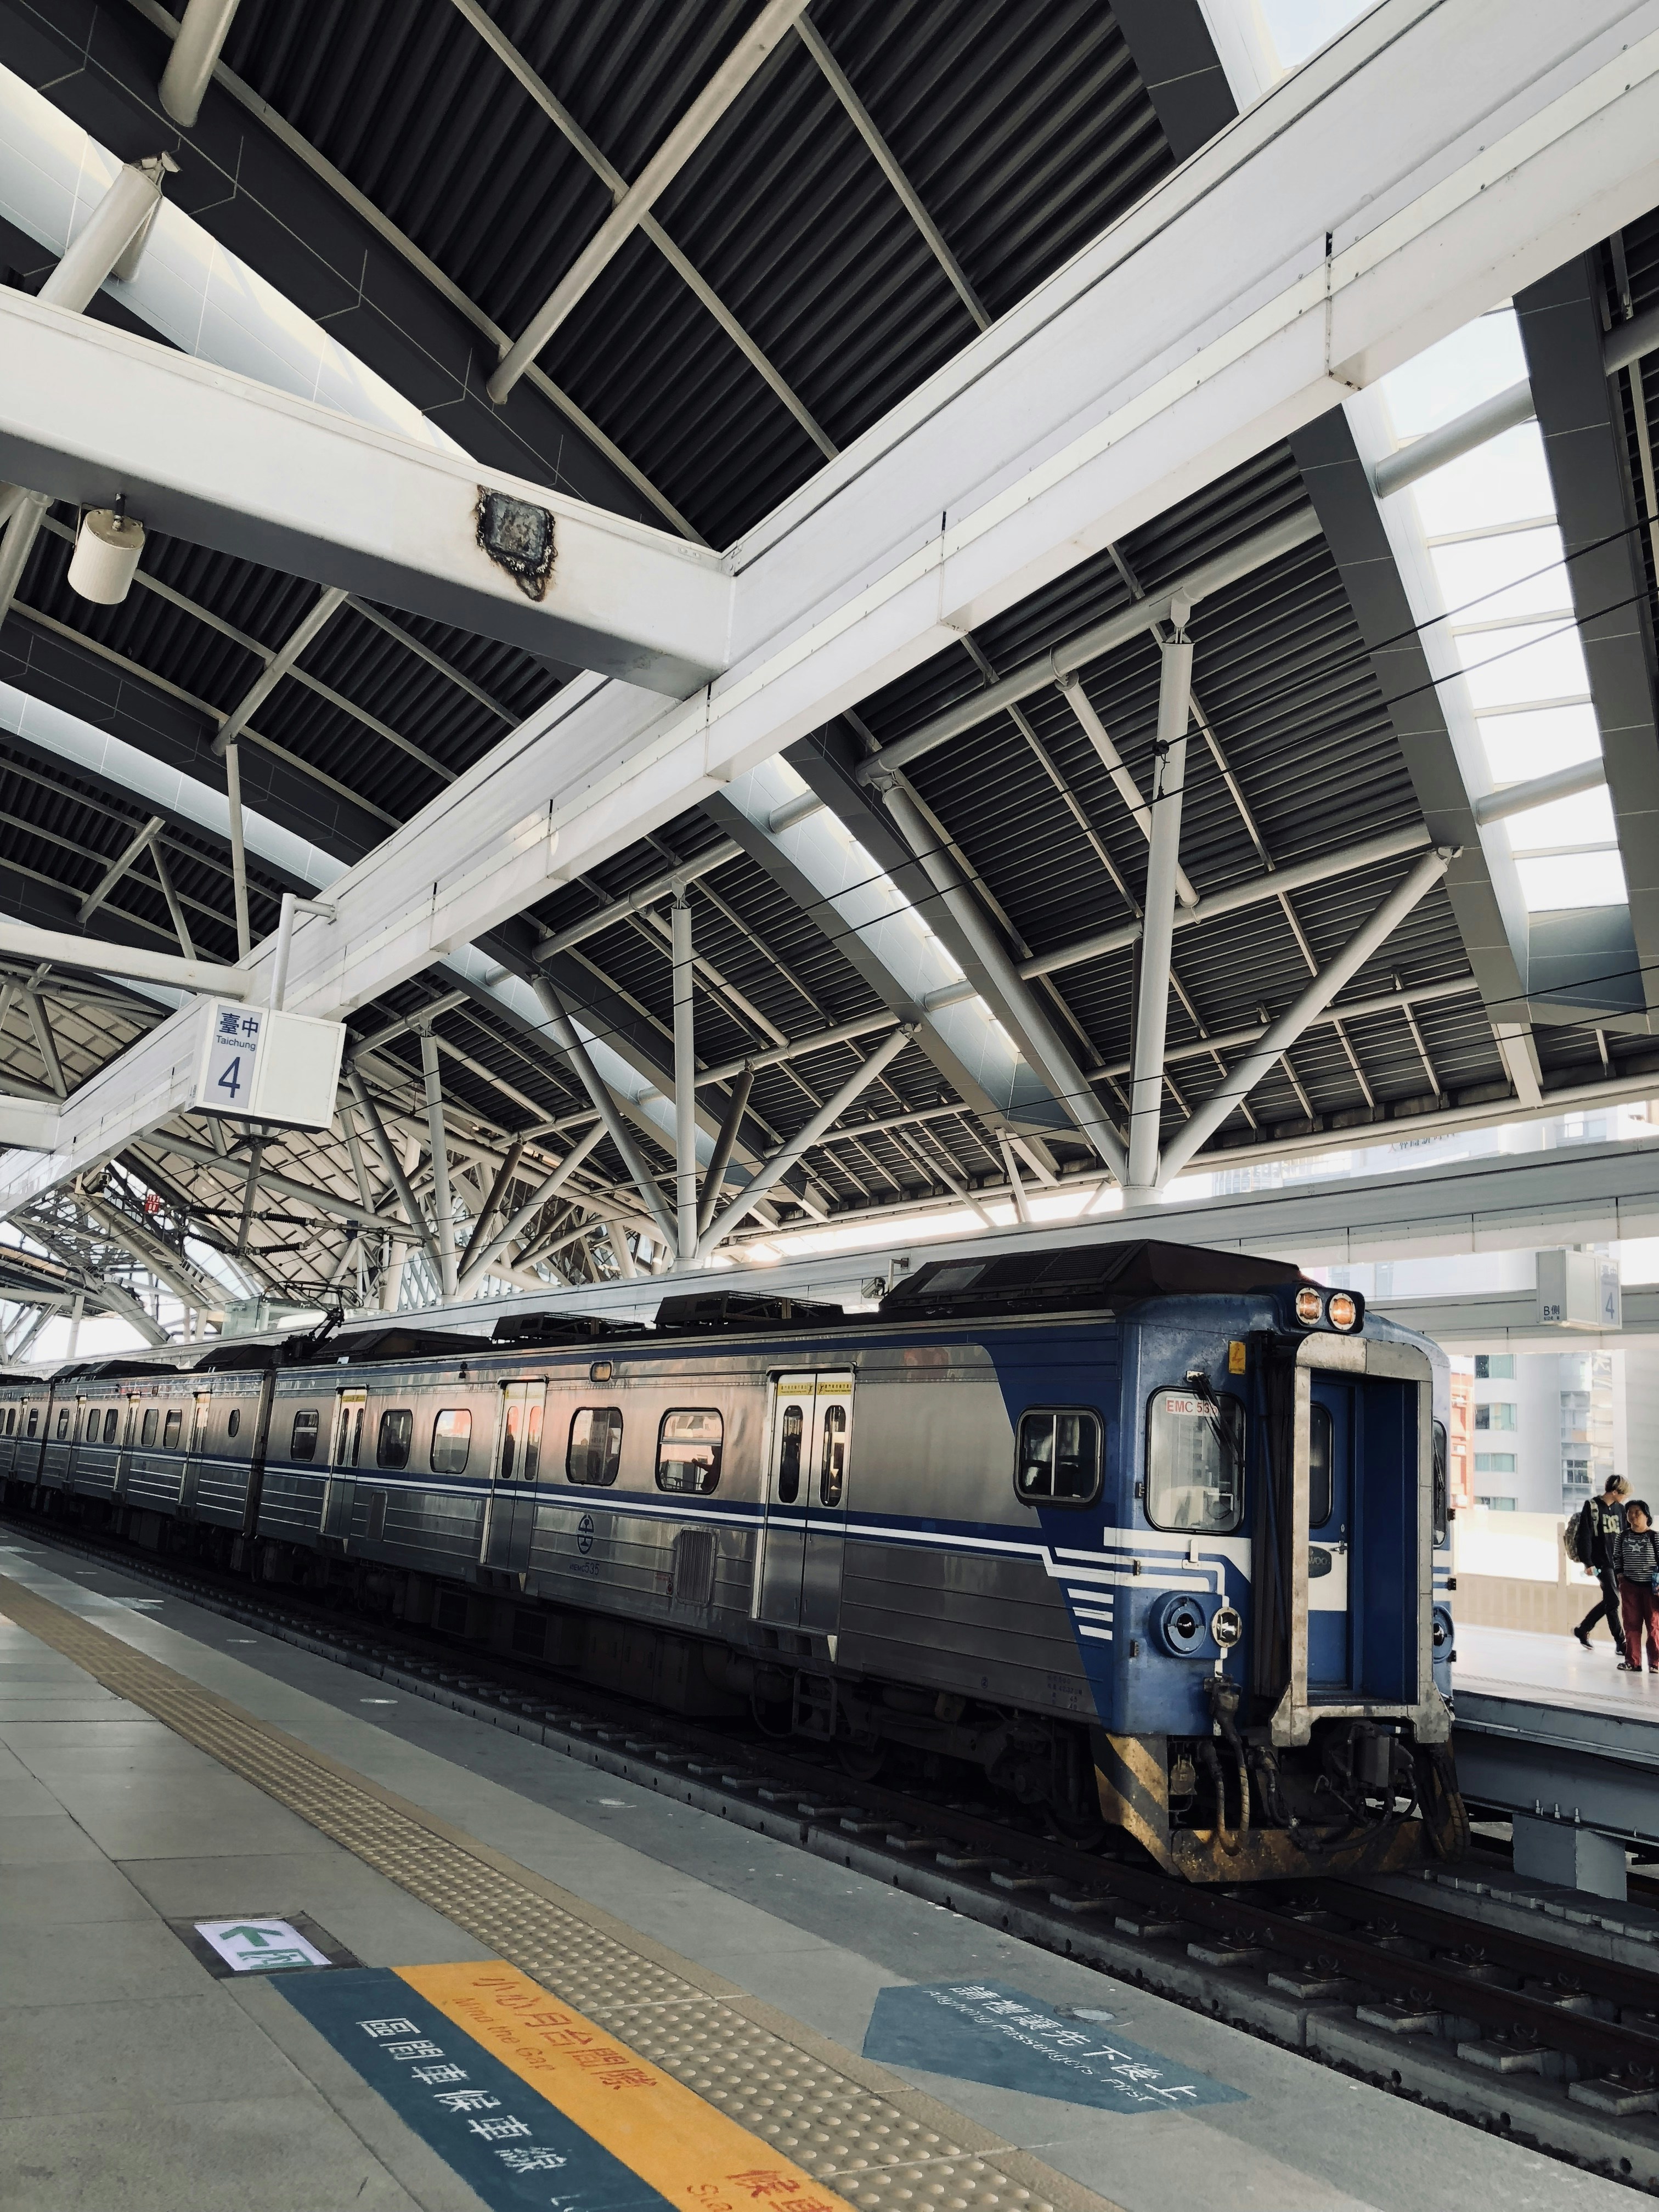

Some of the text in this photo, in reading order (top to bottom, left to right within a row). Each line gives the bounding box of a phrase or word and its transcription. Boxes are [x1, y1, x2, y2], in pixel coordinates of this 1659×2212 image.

[216, 1035, 256, 1051] Taichung
[219, 1013, 259, 1037] 臺中
[218, 1057, 241, 1098] 4
[1605, 1292, 1615, 1319] 4
[1167, 1400, 1193, 1413] EMC
[453, 1997, 556, 2070] Mind the Gap
[472, 1978, 658, 2090] 小心月台間隙
[922, 1990, 1155, 2102] Alighting Passengers First
[948, 1985, 1198, 2101] 請禮讓先下後上
[356, 2018, 567, 2173] 區間車候車線
